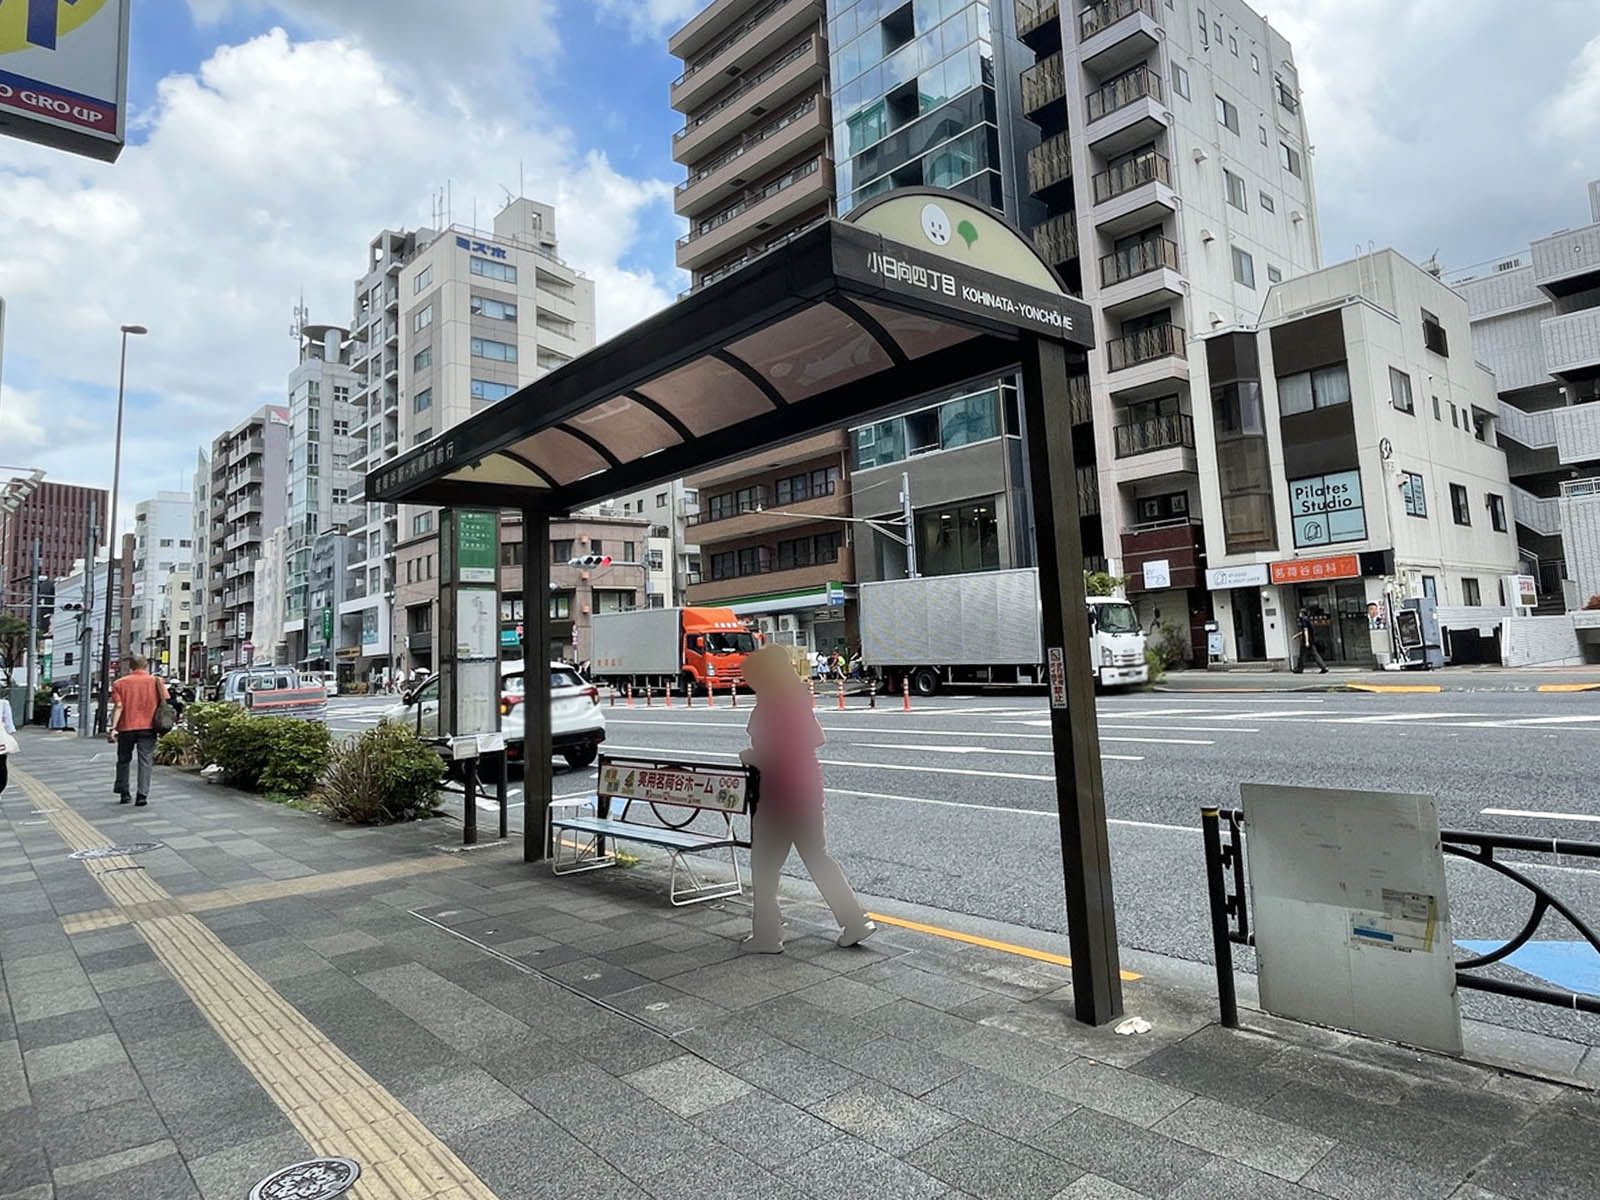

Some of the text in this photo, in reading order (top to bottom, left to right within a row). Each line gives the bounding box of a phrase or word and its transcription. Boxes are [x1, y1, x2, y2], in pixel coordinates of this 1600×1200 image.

[20, 91, 103, 122] GROUP
[867, 252, 956, 296] 小日向四丁目
[1295, 481, 1348, 500] Pilates
[1302, 495, 1352, 513] Studio
